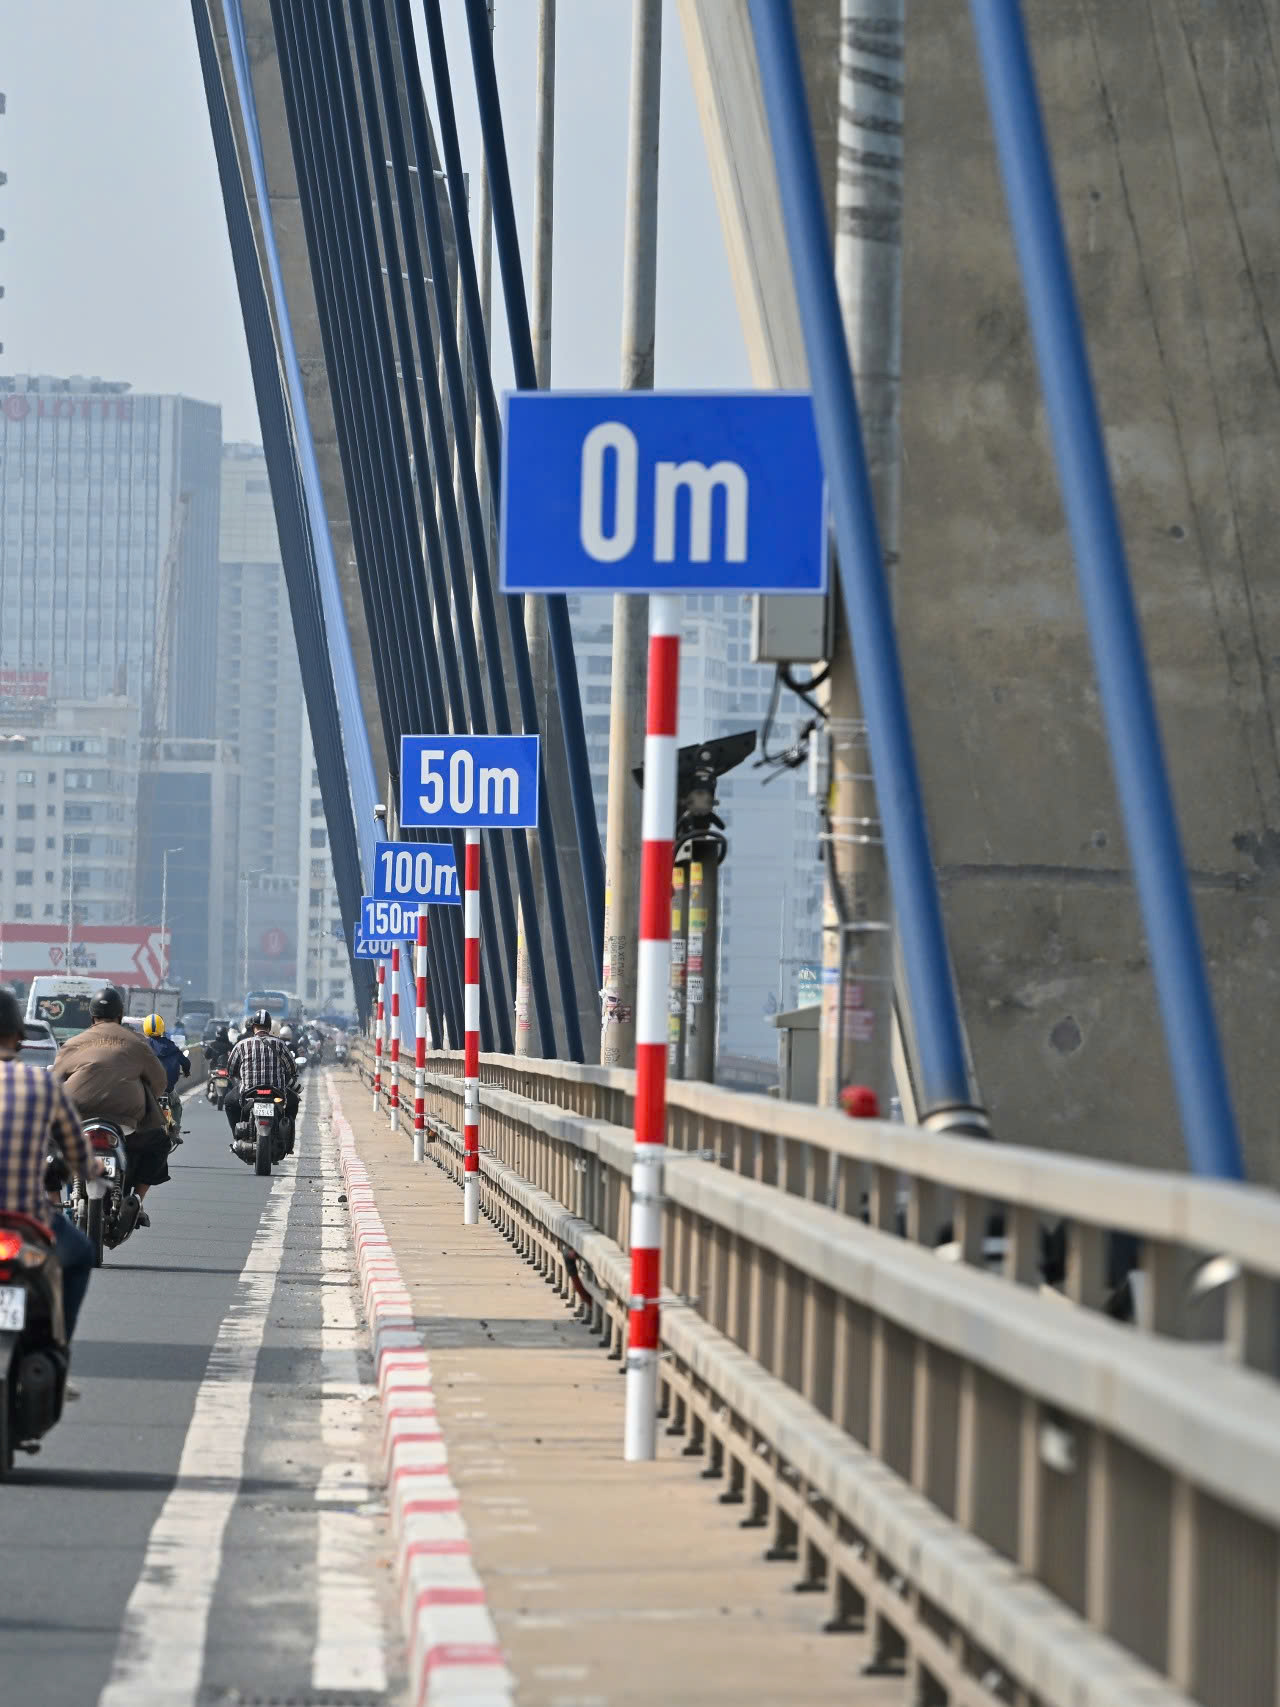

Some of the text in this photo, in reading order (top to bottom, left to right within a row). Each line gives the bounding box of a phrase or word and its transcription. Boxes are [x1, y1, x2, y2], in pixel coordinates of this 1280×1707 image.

[37, 399, 132, 419] LOTTE
[579, 421, 748, 562] 0m
[419, 750, 519, 814] 50m
[381, 851, 460, 896] 100m
[366, 903, 418, 935] 150m
